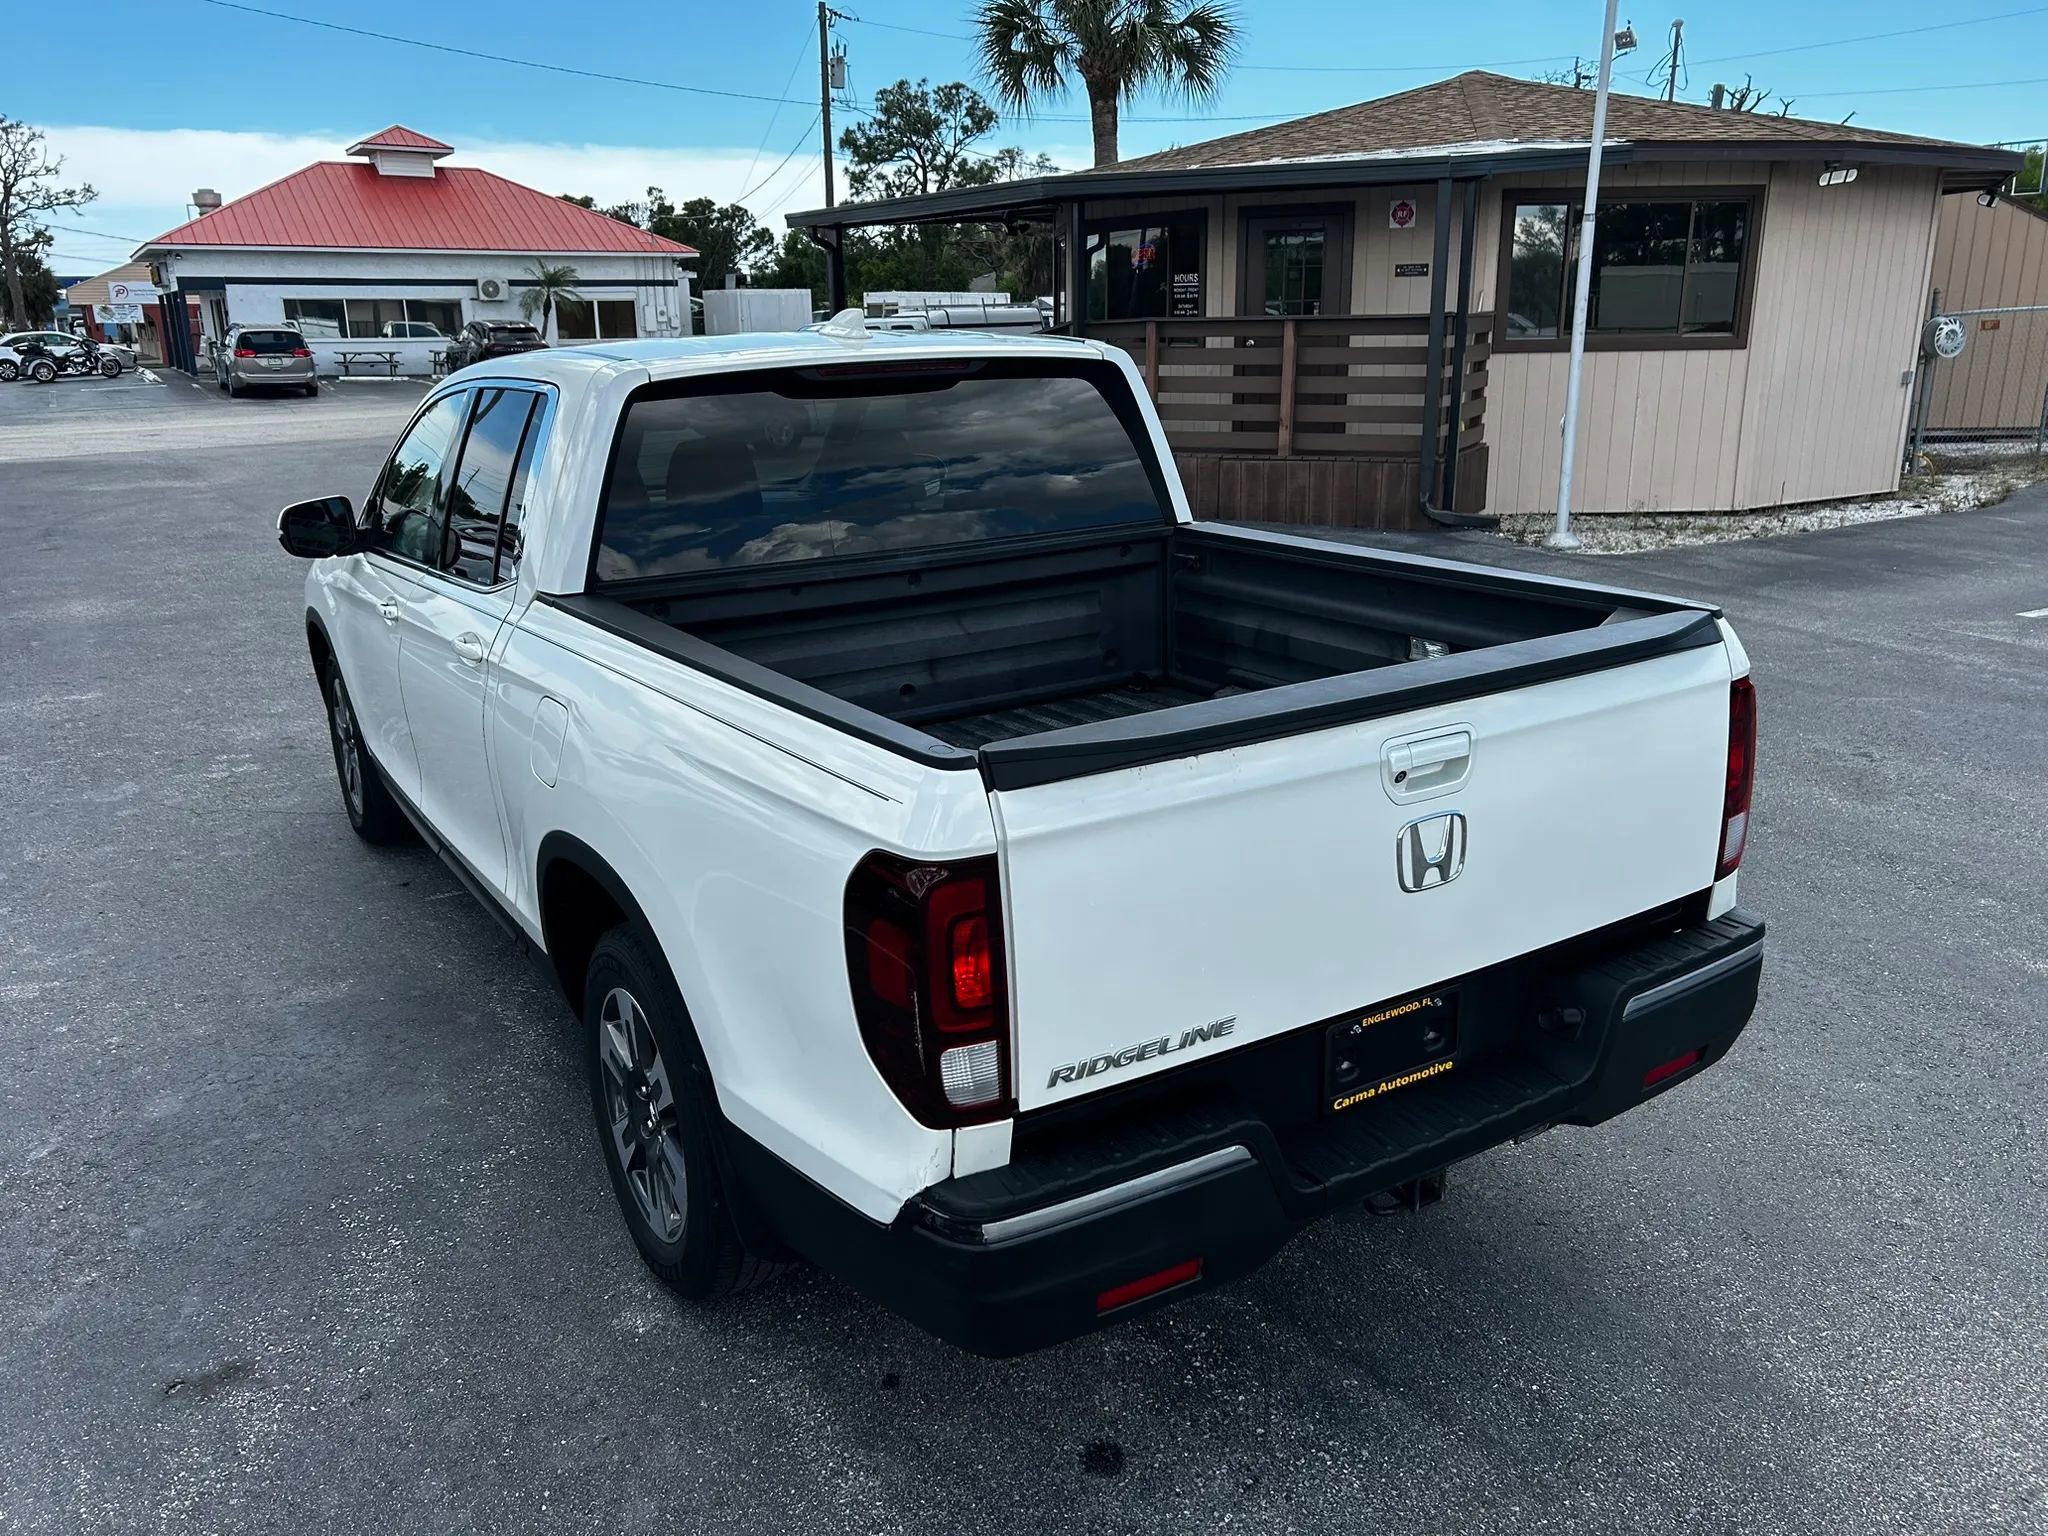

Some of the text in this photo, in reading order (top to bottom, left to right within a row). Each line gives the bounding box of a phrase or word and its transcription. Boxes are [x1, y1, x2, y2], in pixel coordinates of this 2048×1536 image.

[1174, 273, 1199, 283] HOURS
[1362, 997, 1433, 1027] ENGLEWOOD, FL
[1046, 1014, 1238, 1089] RIDGELINE
[1333, 1060, 1454, 1111] Carma Automotive
